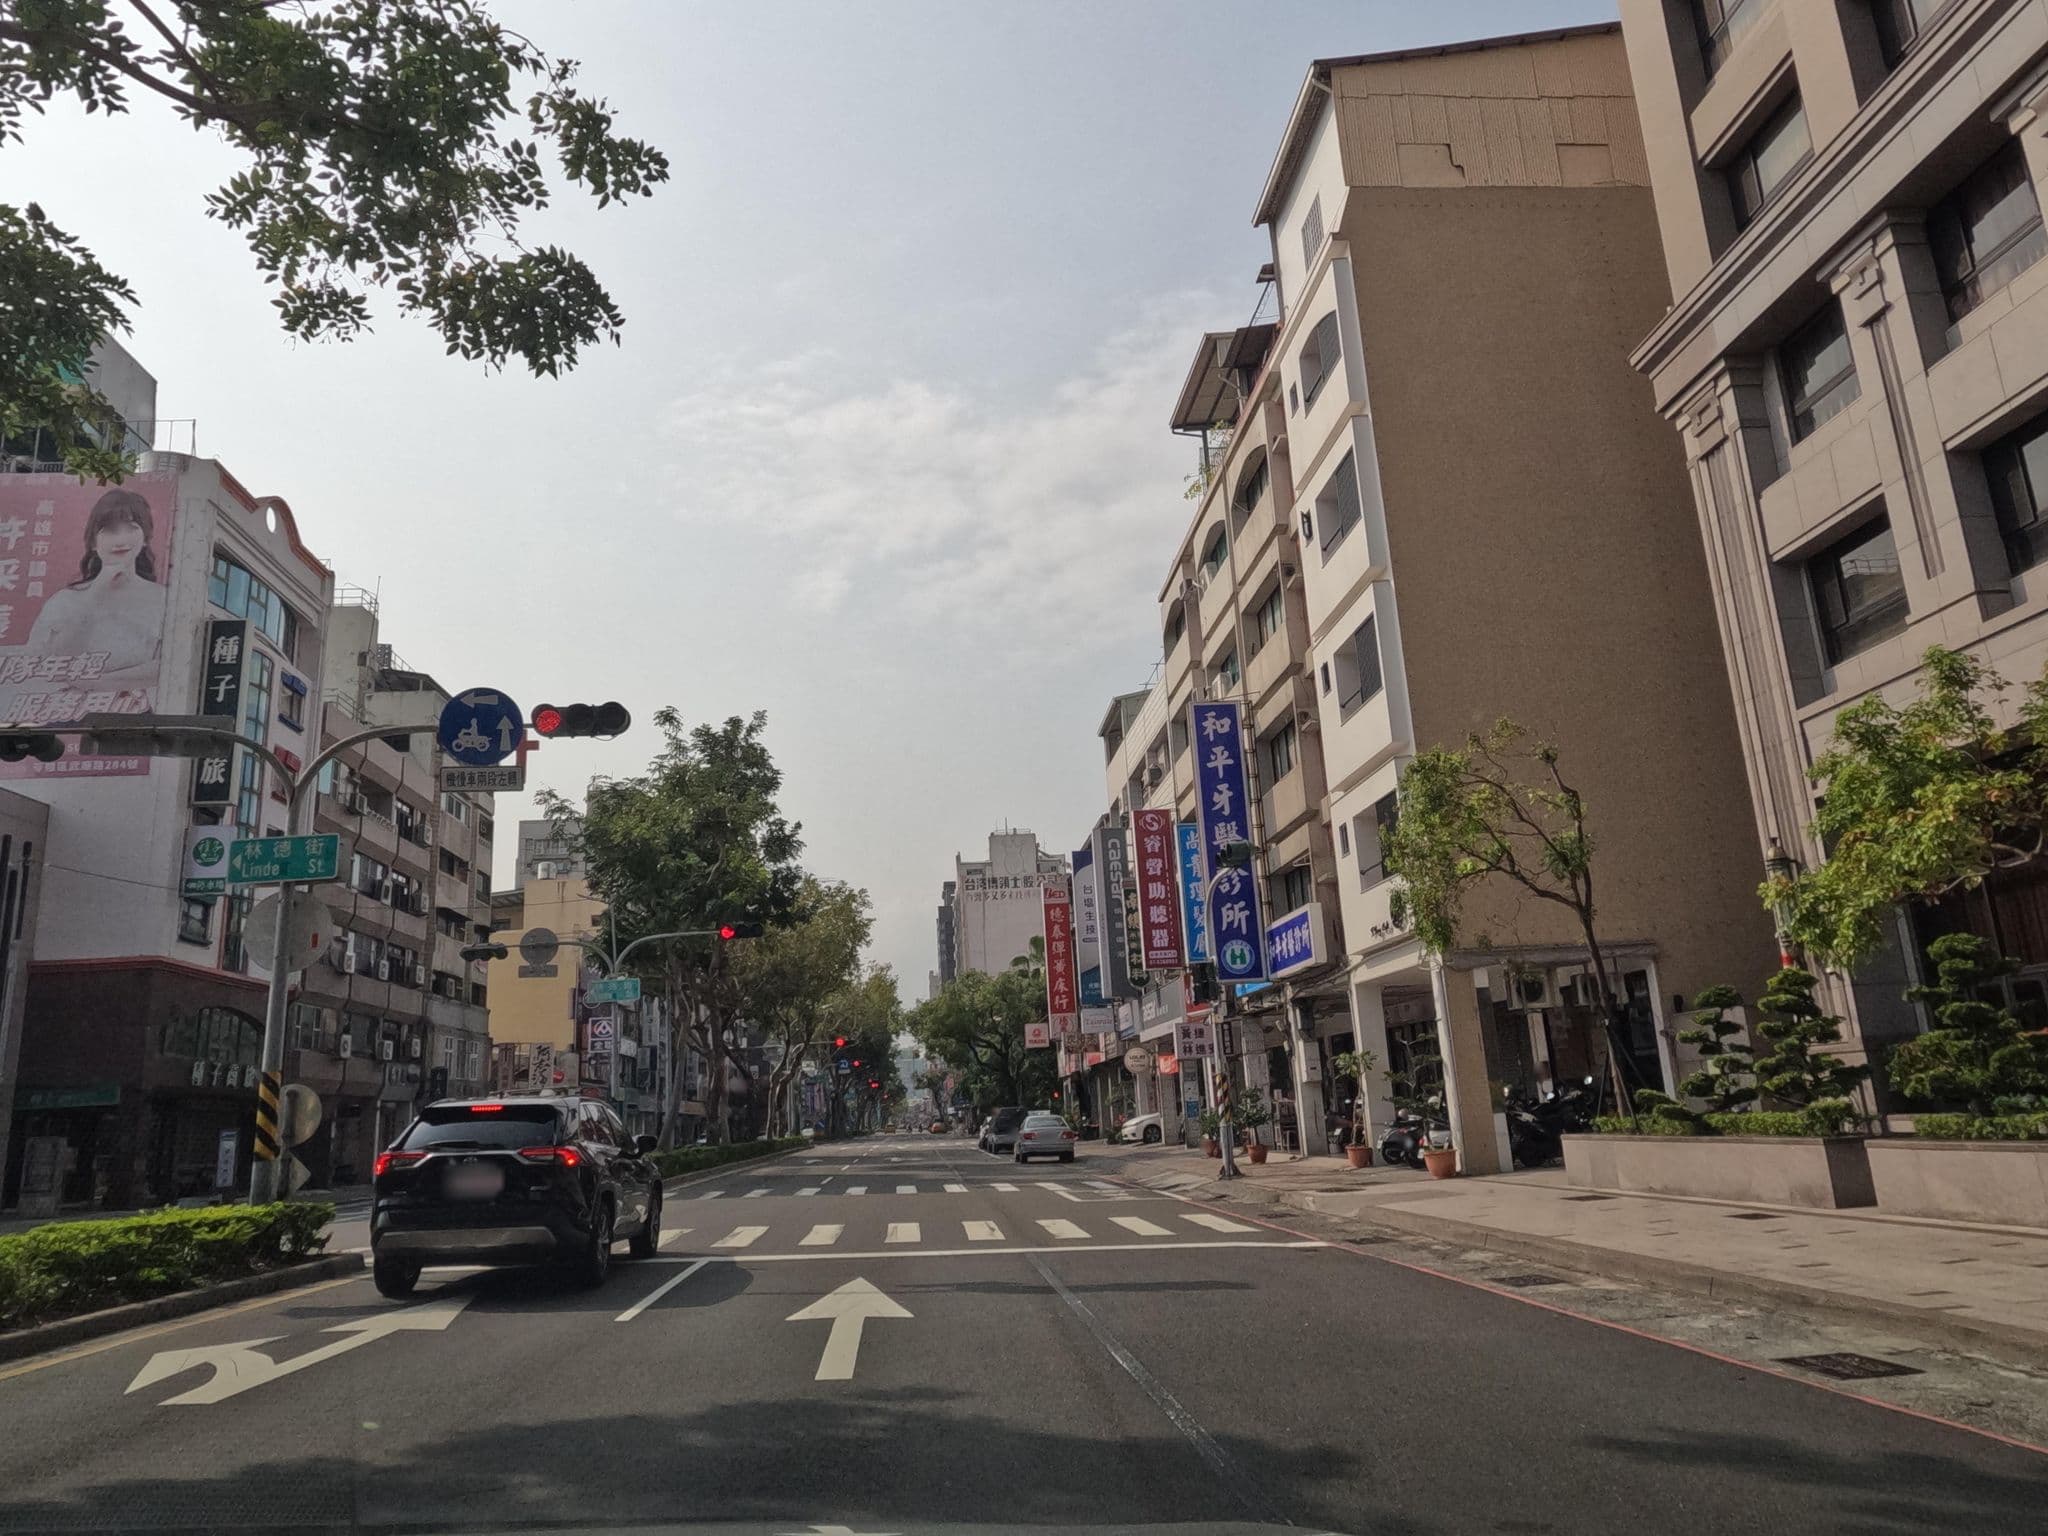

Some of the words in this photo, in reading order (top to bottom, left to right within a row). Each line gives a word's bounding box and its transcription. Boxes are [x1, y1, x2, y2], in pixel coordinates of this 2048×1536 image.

[0, 651, 111, 684] 隊年輕
[200, 635, 240, 785] 種子旅
[1202, 711, 1249, 935] 和平牙醫診所
[242, 861, 280, 878] Linde
[308, 858, 326, 874] St
[244, 838, 328, 859] 林德街
[1108, 838, 1122, 900] caesar
